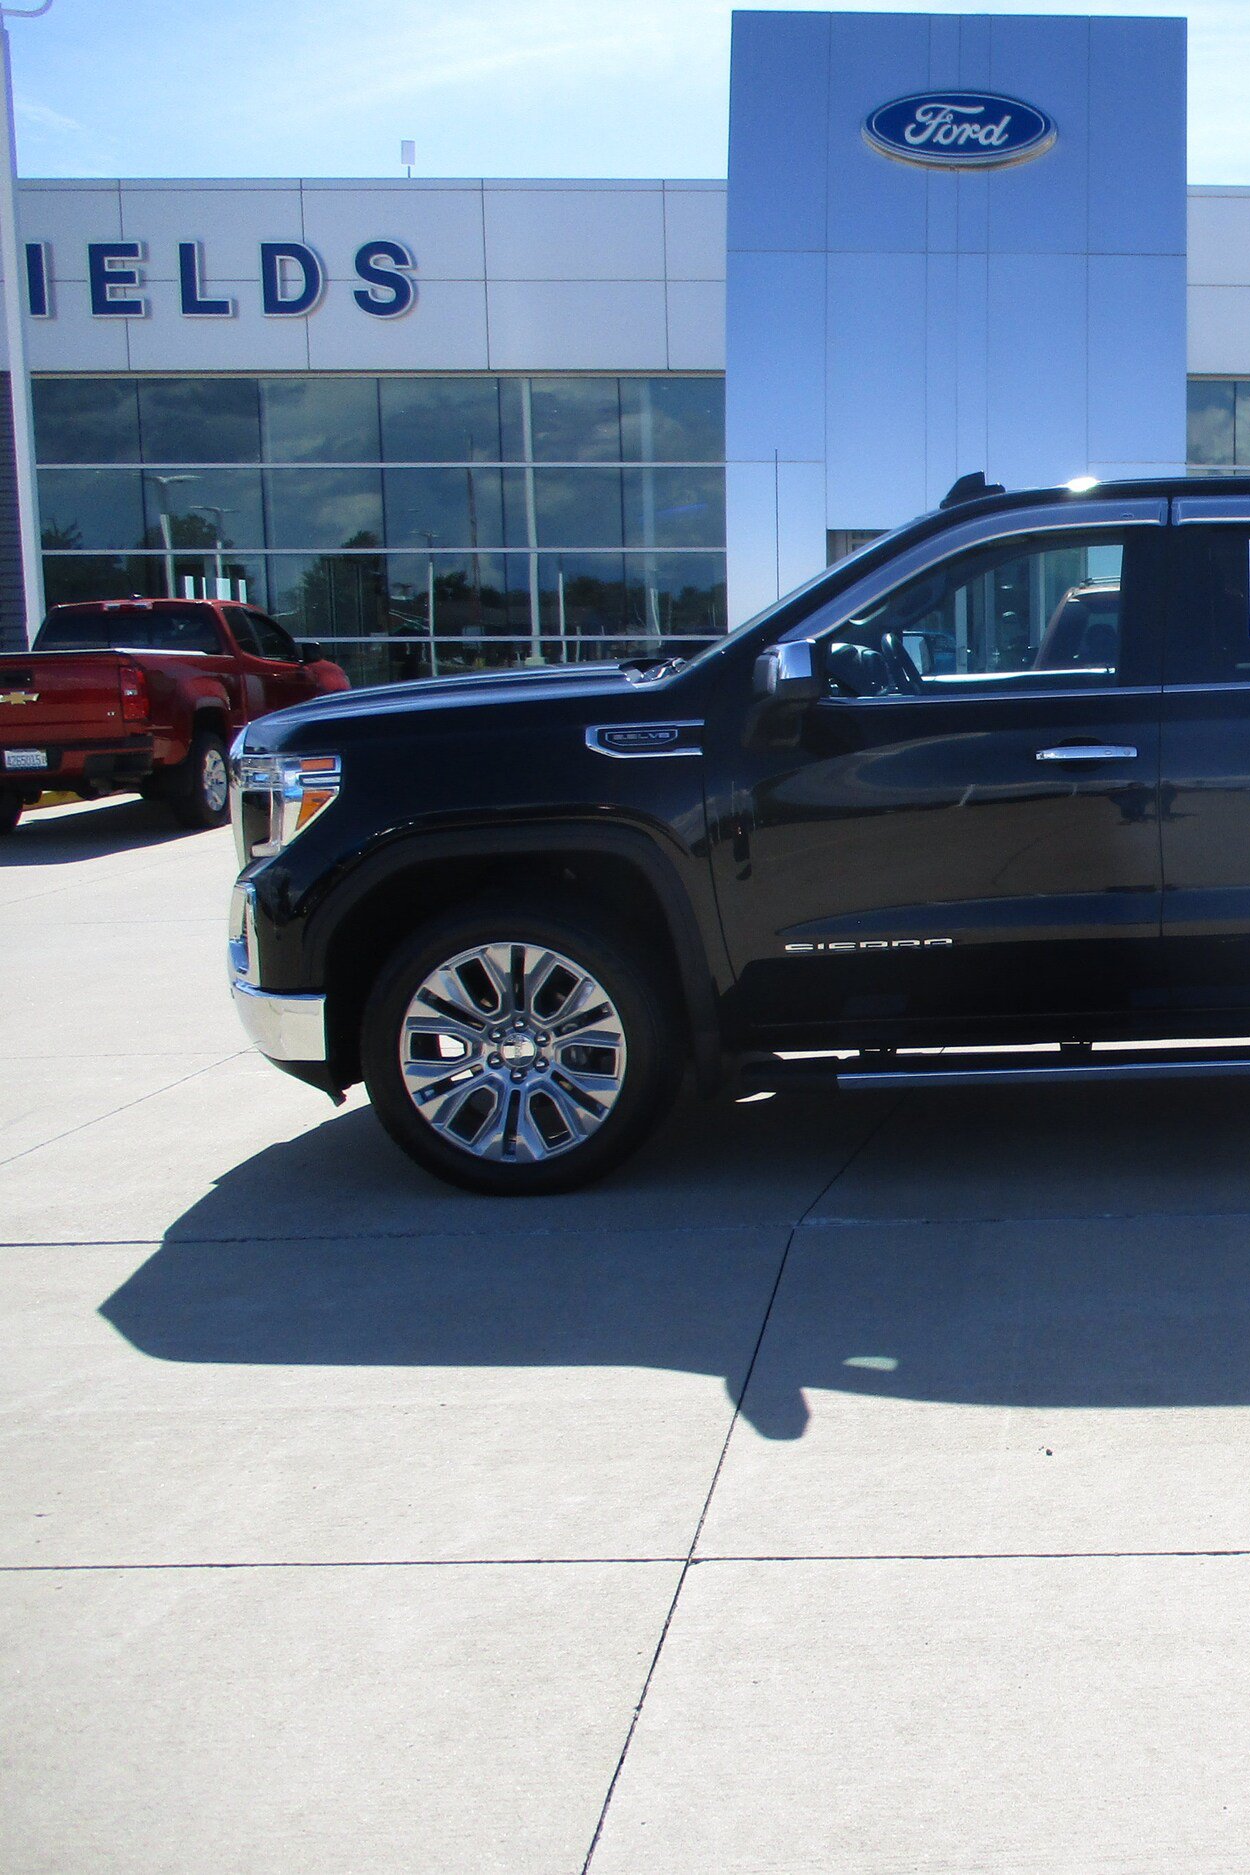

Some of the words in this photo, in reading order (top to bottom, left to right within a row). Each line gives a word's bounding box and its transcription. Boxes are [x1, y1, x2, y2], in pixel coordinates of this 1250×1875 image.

[905, 104, 1012, 147] Ford
[24, 240, 417, 319] IELDS
[785, 938, 953, 952] SIERRA
